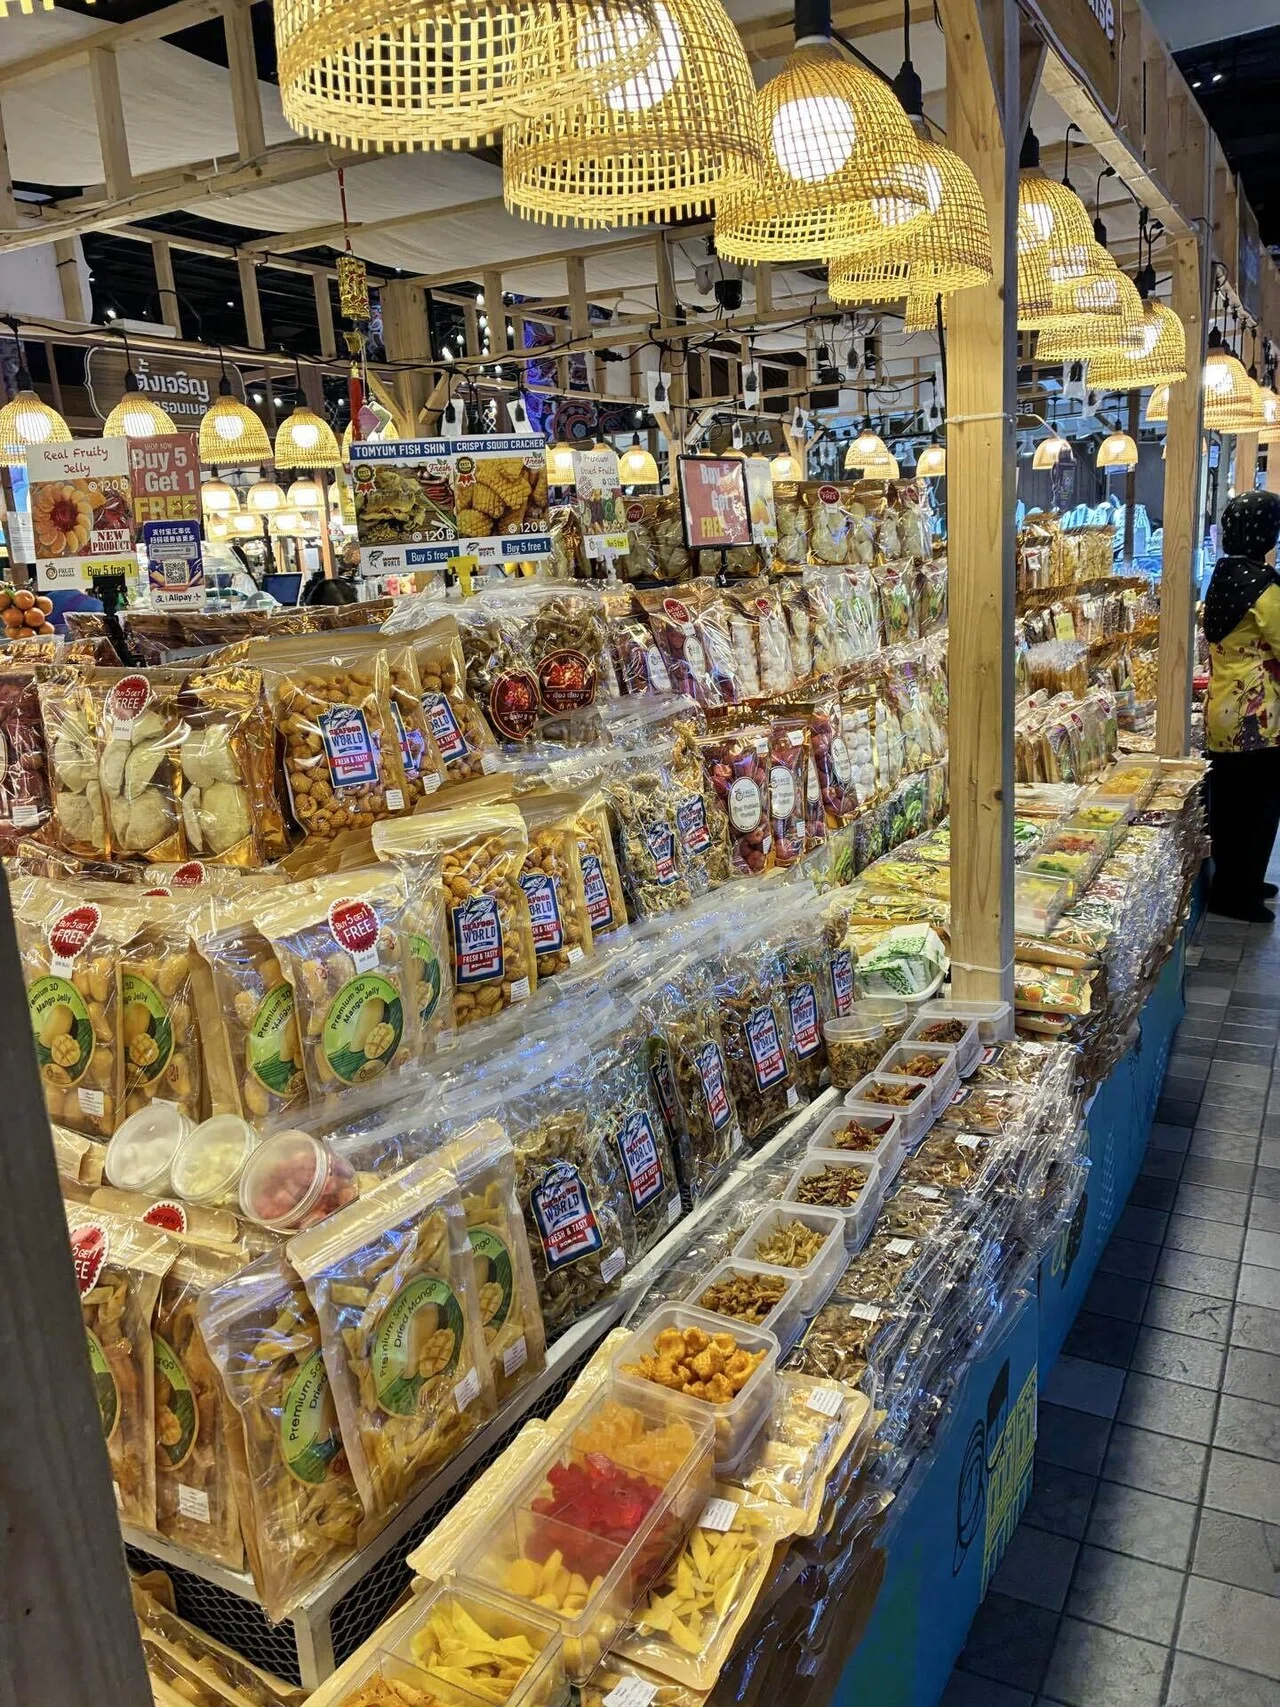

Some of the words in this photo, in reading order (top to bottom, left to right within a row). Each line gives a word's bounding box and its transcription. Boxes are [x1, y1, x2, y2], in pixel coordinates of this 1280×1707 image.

[43, 451, 69, 461] Real
[73, 446, 109, 461] Fruity
[355, 445, 397, 458] TOMYUM
[400, 443, 421, 456] FISH
[456, 442, 484, 451] CRISPY
[132, 449, 170, 473] Buy
[174, 447, 187, 467] 5
[63, 463, 91, 477] Jelly
[145, 471, 179, 493] Get
[185, 470, 195, 491] 1
[134, 494, 197, 523] FREE
[97, 530, 124, 541] NEW
[92, 541, 131, 552] PRODUCT
[506, 544, 520, 554] Buy
[521, 542, 528, 552] 5
[527, 541, 541, 551] free
[411, 553, 425, 562] Buy
[427, 552, 433, 560] 5
[434, 550, 449, 560] free
[87, 565, 102, 577] Buy
[103, 565, 110, 576] 5
[110, 564, 126, 574] free
[116, 698, 140, 709] FREE
[331, 732, 364, 747] WORLD
[529, 901, 553, 916] ORLD
[69, 919, 77, 929] 5
[334, 921, 348, 931] BUY
[345, 913, 354, 925] 5
[352, 911, 365, 922] GET
[361, 906, 369, 917] 1
[55, 929, 85, 945] FREE
[343, 918, 374, 943] FREE
[463, 927, 496, 943] WORLD
[462, 953, 479, 963] FRESH
[484, 949, 499, 959] TASTY
[30, 986, 49, 1008] remium
[36, 996, 55, 1014] Mango
[56, 993, 72, 1004] Jelly
[331, 993, 355, 1030] Premium
[355, 982, 365, 994] 3D
[343, 999, 364, 1024] Mango
[364, 986, 380, 999] Jelly
[257, 1001, 283, 1039] Premium
[283, 989, 292, 1001] 3D
[628, 1140, 653, 1167] WORLD
[544, 1193, 580, 1223] WORLD
[548, 1230, 566, 1246] FRESH
[566, 1227, 572, 1235] &
[572, 1218, 588, 1233] TASTY
[79, 1249, 93, 1259] GET
[92, 1245, 101, 1260] 1
[394, 1313, 409, 1348] Dried
[408, 1282, 437, 1314] Mango
[380, 1321, 395, 1378] Premium
[309, 1373, 328, 1409] Dried
[289, 1379, 312, 1441] Premium
[310, 1362, 322, 1378] So
